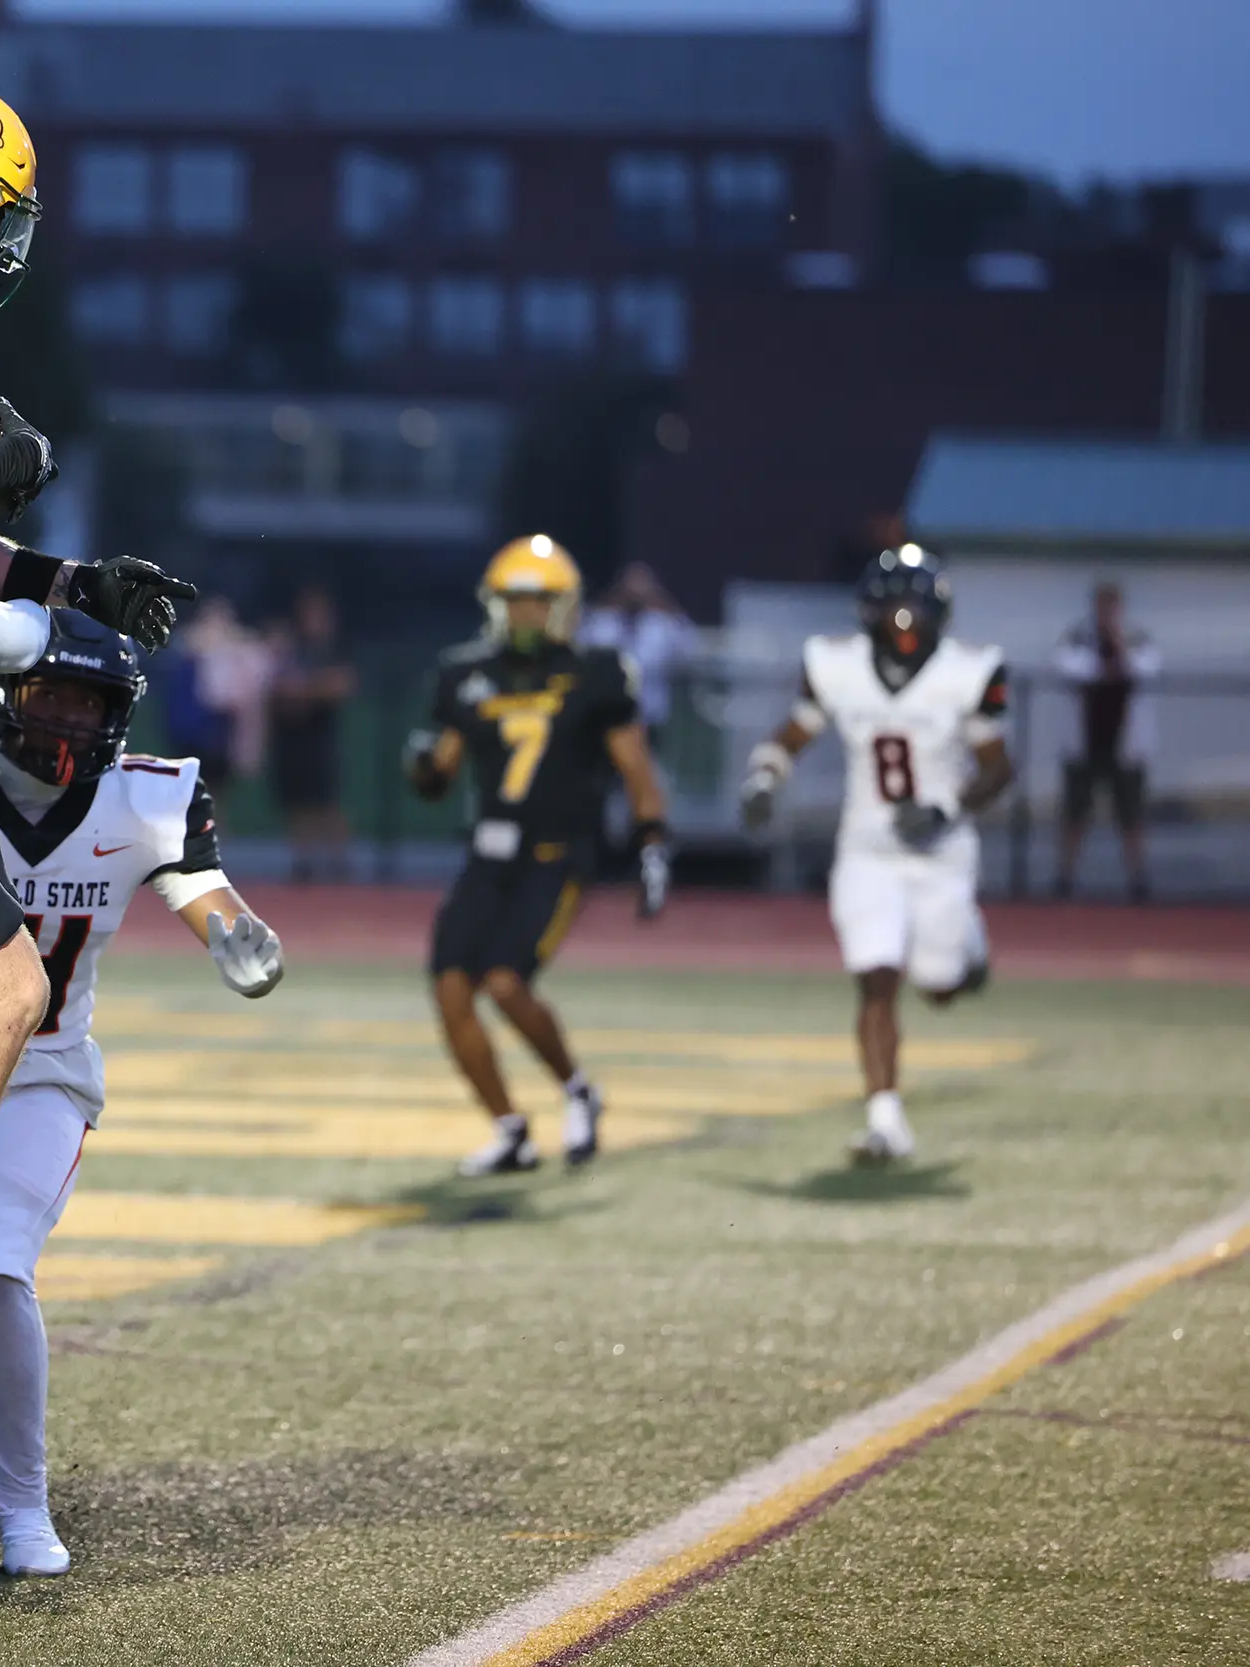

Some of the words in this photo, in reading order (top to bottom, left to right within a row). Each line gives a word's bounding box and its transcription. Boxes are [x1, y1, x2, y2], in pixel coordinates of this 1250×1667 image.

[59, 650, 105, 669] Riddell
[498, 710, 552, 804] 7
[871, 734, 916, 804] 8
[47, 881, 111, 908] STATE
